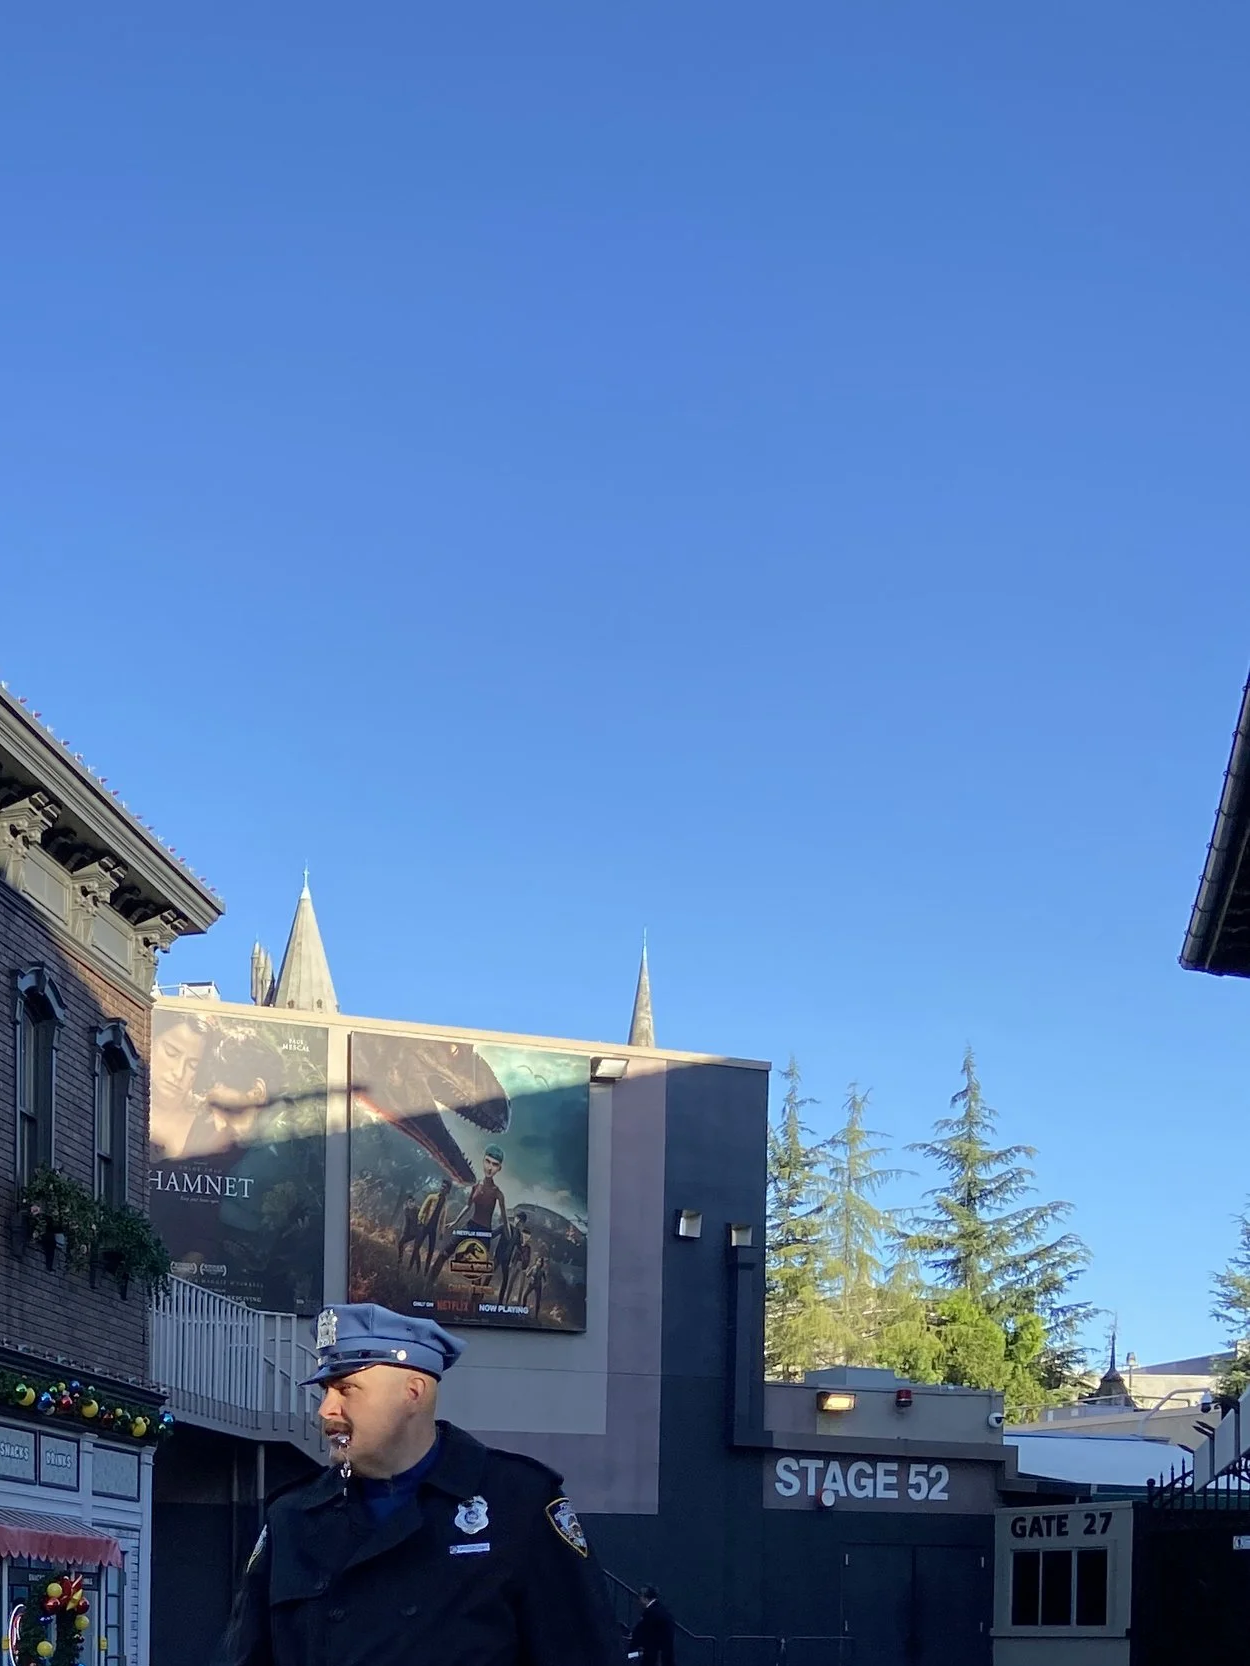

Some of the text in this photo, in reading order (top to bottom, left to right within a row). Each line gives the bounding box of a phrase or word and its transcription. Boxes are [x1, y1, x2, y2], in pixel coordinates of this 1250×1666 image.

[148, 1169, 254, 1198] HAMNET
[437, 1300, 469, 1312] NETFLIX
[479, 1304, 497, 1313] NOW
[498, 1305, 529, 1315] PLAYING
[0, 1441, 29, 1462] SNACKS
[45, 1450, 72, 1469] DRINKS
[774, 1457, 950, 1501] STAGE 52
[1010, 1512, 1113, 1539] GATE 27
